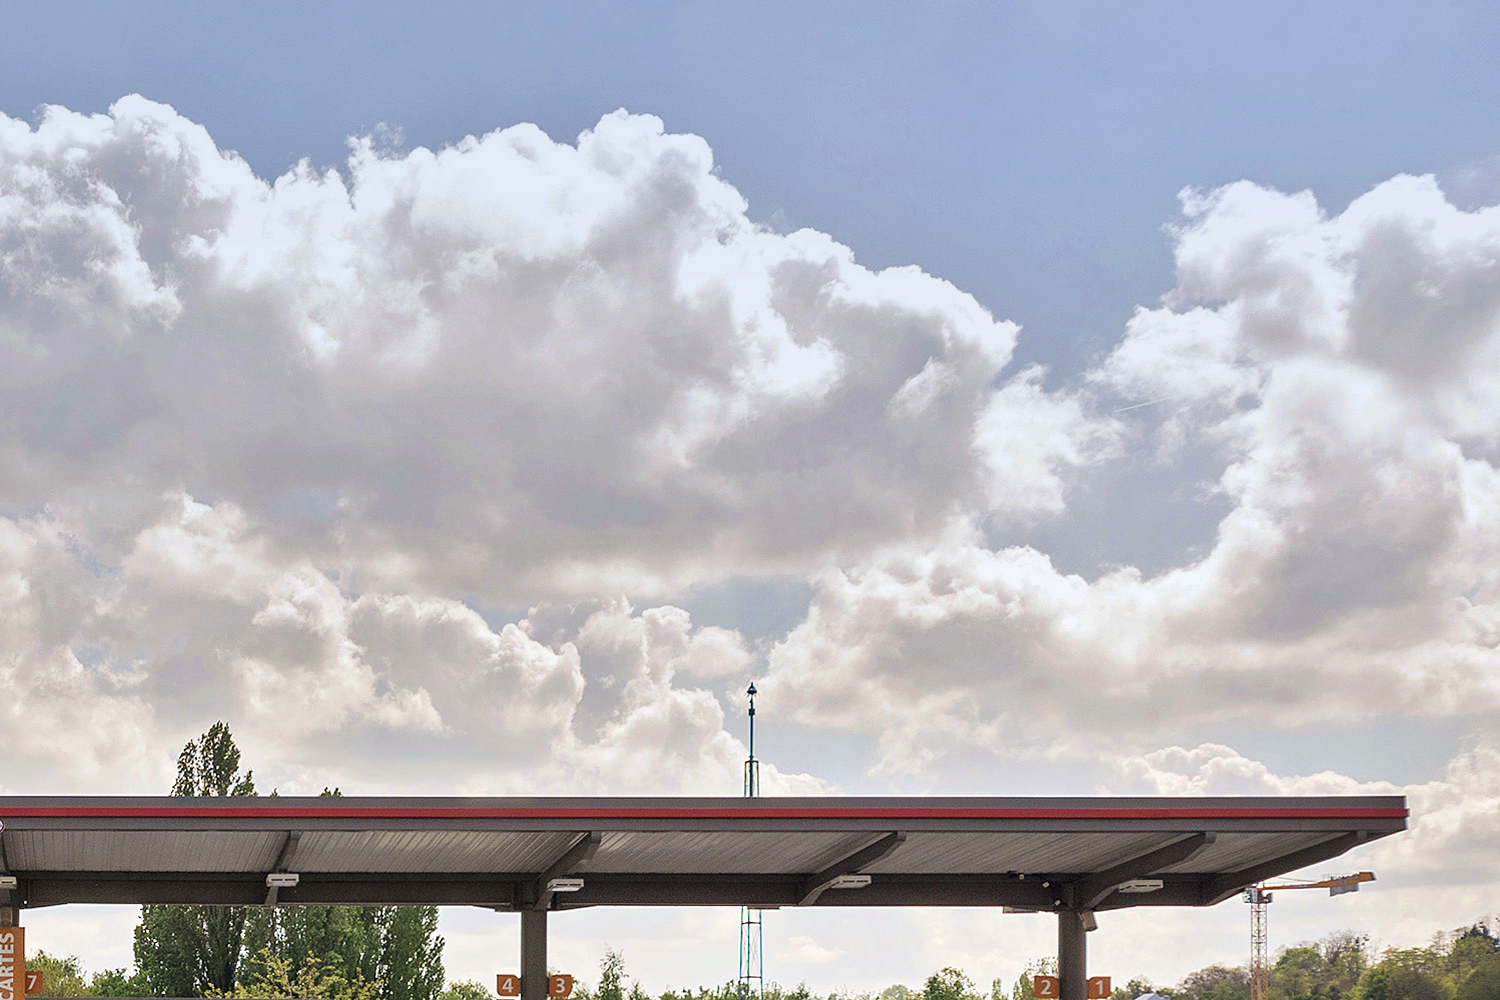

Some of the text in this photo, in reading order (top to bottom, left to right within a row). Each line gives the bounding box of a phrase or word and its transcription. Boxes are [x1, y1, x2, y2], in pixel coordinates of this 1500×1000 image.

[27, 974, 38, 990] 7
[502, 978, 514, 993] 4
[555, 978, 566, 994] 3
[1040, 979, 1053, 996] 2
[1095, 979, 1105, 996] 1
